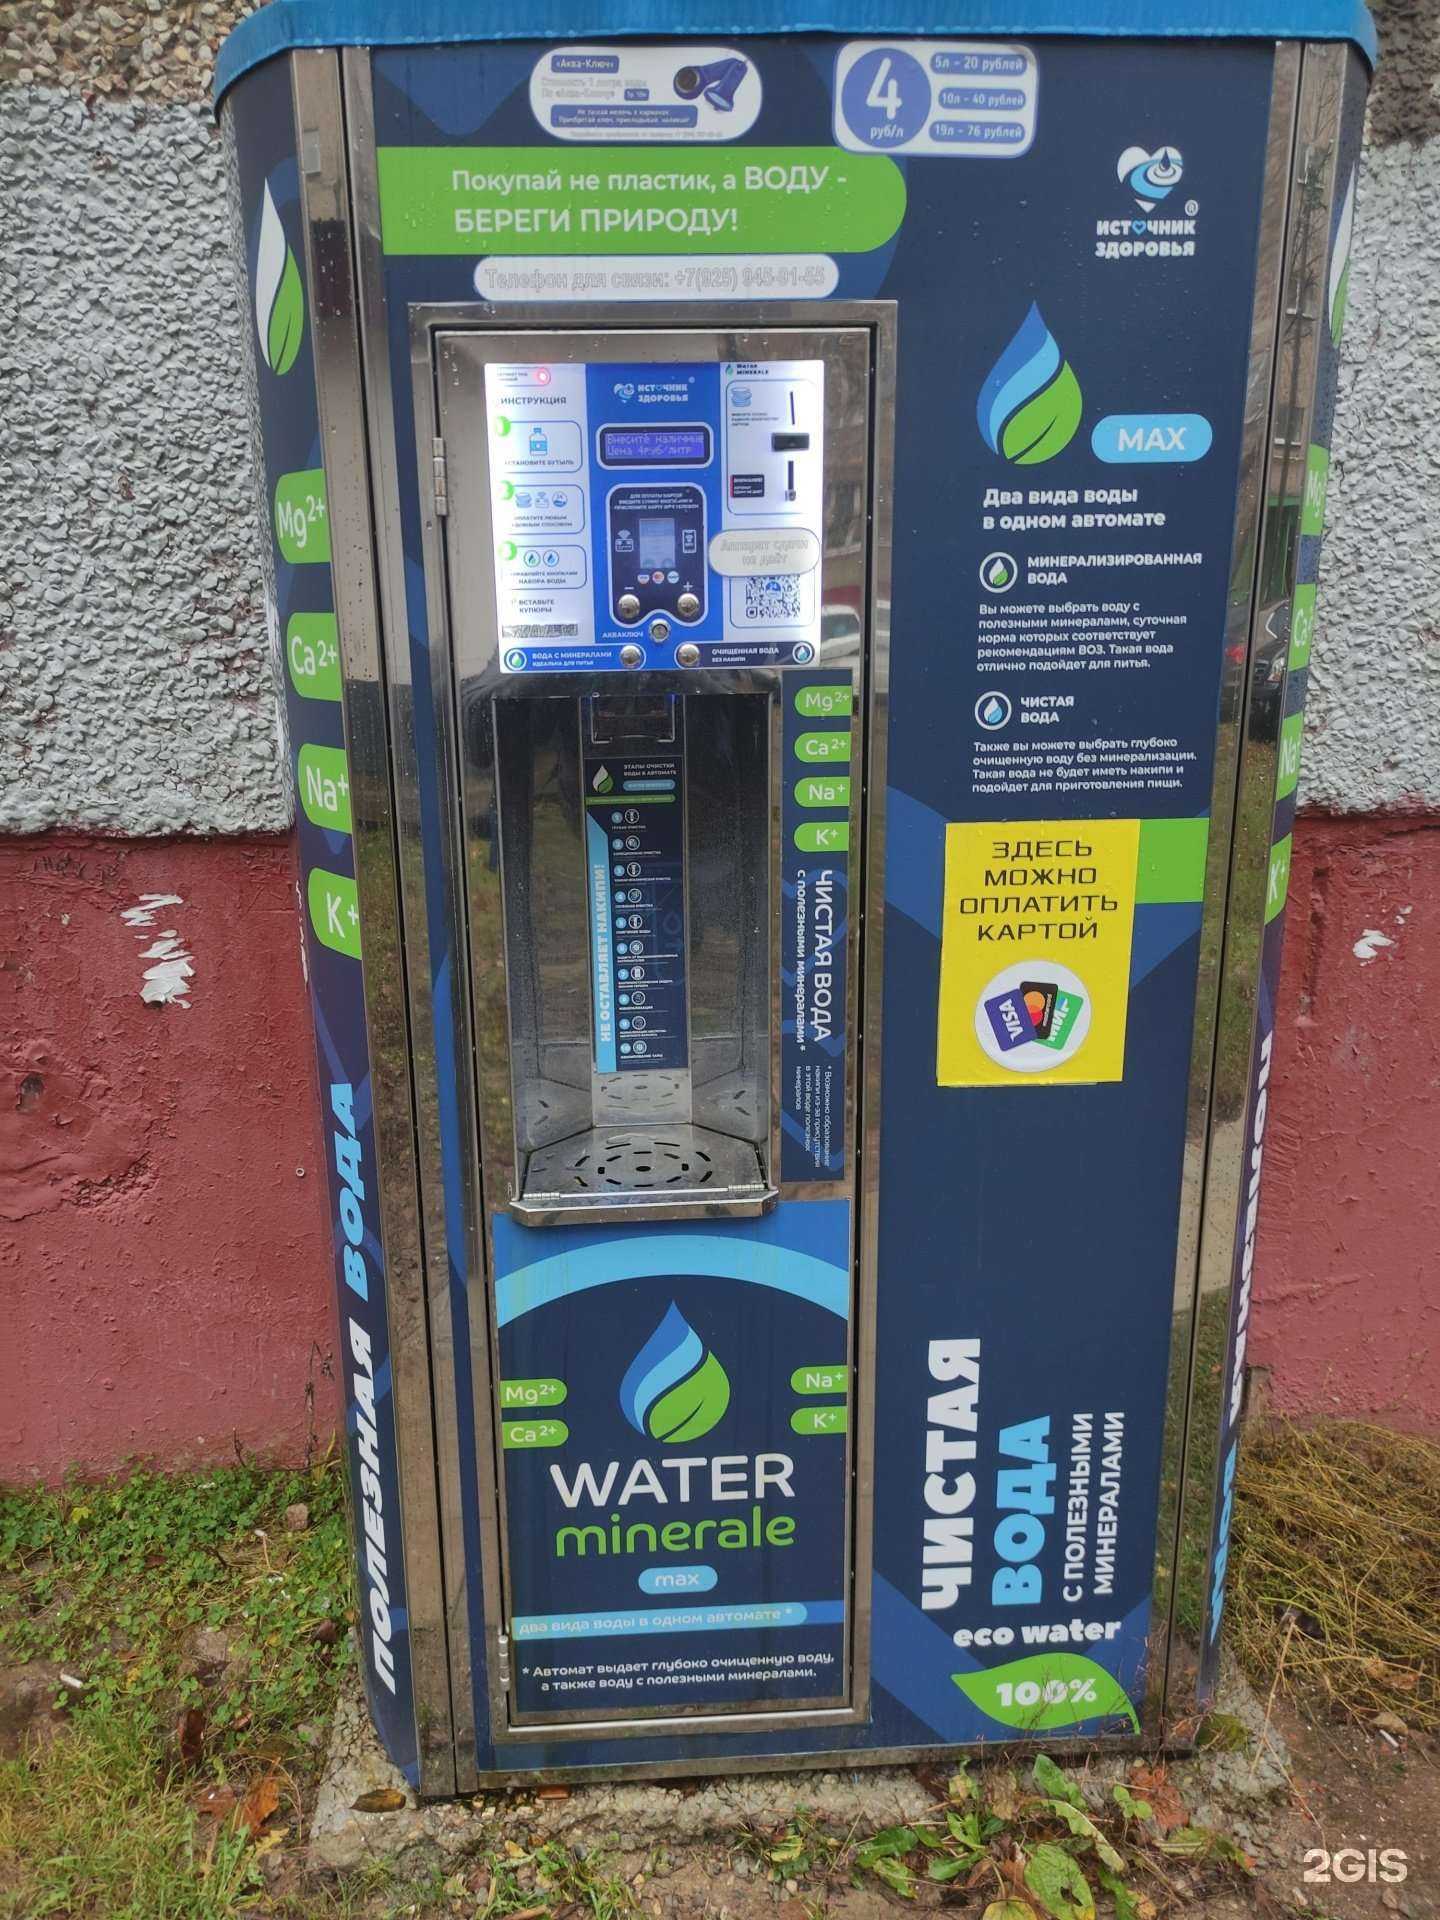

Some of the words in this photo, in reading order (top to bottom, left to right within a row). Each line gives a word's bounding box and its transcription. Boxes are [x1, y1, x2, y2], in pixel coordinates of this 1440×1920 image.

[935, 56, 950, 69] 5л
[964, 57, 978, 69] 20
[982, 58, 1024, 72] рублей
[866, 57, 903, 120] 4
[973, 93, 985, 104] 40
[988, 94, 1024, 108] рублей
[870, 124, 904, 140] руб/л
[967, 125, 981, 136] 76
[984, 126, 1022, 139] рублей
[452, 169, 563, 197] Покупай
[570, 173, 600, 191] не
[607, 173, 717, 195] пластик,
[722, 174, 738, 190] а
[744, 165, 830, 194] ВОДУ
[454, 207, 571, 233] БЕРЕГИ
[580, 207, 739, 235] ПРИРОДУ!
[1095, 240, 1196, 259] ЗДОРОВЬЯ
[485, 269, 568, 294] Телефон
[571, 272, 607, 291] для
[501, 396, 567, 406] ИНСТРУКЦИЯ
[638, 394, 689, 403] ЗДОРОВЬЯ
[607, 446, 632, 457] Цена
[983, 488, 1024, 508] Два
[1028, 488, 1079, 506] вида
[1084, 486, 1138, 505] воды
[983, 516, 994, 529] в
[999, 514, 1067, 532] одном
[1072, 512, 1167, 529] автомате
[1027, 553, 1203, 568] МИНЕРАЛИЗИРОВАННАЯ
[1027, 572, 1068, 586] ВОДА
[979, 604, 997, 614] Вы
[999, 603, 1046, 614] можете
[1048, 602, 1099, 614] выбрать
[1101, 602, 1131, 614] воду
[979, 619, 1048, 630] полезными
[1050, 617, 1130, 629] минералами,
[1133, 615, 1187, 628] суточная
[978, 632, 1017, 644] норма
[1019, 631, 1069, 643] которых
[1071, 629, 1157, 643] соответствует
[977, 645, 1076, 660] рекомендациям
[1078, 644, 1106, 655] ВОЗ.
[1108, 643, 1143, 655] Такая
[1145, 644, 1174, 655] вода
[977, 660, 1026, 672] отлично
[1028, 658, 1087, 672] подойдет
[1088, 658, 1111, 670] для
[1113, 658, 1151, 669] питья.
[1020, 695, 1075, 709] ЧИСТАЯ
[1020, 711, 1060, 725] ВОДА
[974, 742, 1010, 753] Также
[1012, 741, 1029, 751] вы
[1031, 740, 1076, 751] можете
[1078, 738, 1128, 750] выбрать
[1130, 737, 1178, 749] глубоко
[973, 755, 1044, 767] очищенную
[1046, 754, 1074, 766] воду
[1076, 752, 1097, 764] без
[1099, 751, 1197, 763] минерализации.
[973, 769, 1006, 780] Такая
[1008, 768, 1036, 779] вода
[1039, 769, 1054, 778] не
[1056, 766, 1090, 778] будет
[1091, 766, 1127, 778] иметь
[1130, 765, 1173, 776] накипи
[1176, 765, 1184, 775] и
[808, 783, 846, 801] Na+
[972, 782, 1029, 794] подойдет
[1030, 781, 1052, 794] для
[1055, 780, 1145, 793] приготовления
[1147, 778, 1183, 790] пищи.
[816, 828, 839, 846] K+
[992, 840, 1093, 863] ЗДЕСЬ
[984, 867, 1097, 887] МОЖНО
[594, 864, 608, 933] НАКИПИ!
[960, 895, 1119, 915] ОПЛАТИТЬ
[796, 879, 806, 957] полезными
[814, 869, 833, 967] ЧИСТАЯ
[977, 916, 1098, 941] КАРТОЙ
[597, 935, 611, 1021] ОСТАВЛЯЕТ
[811, 972, 833, 1042] ВОДА
[999, 998, 1024, 1042] VISA
[600, 1023, 612, 1042] НЕ
[330, 1082, 371, 1304] ВОДА
[805, 1370, 845, 1389] Na+
[505, 1384, 558, 1404] Mg2+
[813, 1411, 839, 1429] K+
[509, 1424, 558, 1444] Ca2+
[549, 1452, 796, 1509] WATER
[921, 1338, 982, 1611] ЧИСТАЯ
[992, 1415, 1058, 1606] ВОДА
[1062, 1411, 1094, 1579] ПОЛЕЗНЫМИ
[1093, 1411, 1125, 1597] МИНЕРАЛАМИ
[348, 1316, 397, 1696] ПОЛЕЗНАЯ
[555, 1504, 797, 1558] minerale
[655, 1571, 700, 1588] max
[1062, 1584, 1083, 1603] С
[518, 1621, 548, 1636] два
[551, 1619, 590, 1634] вида
[593, 1616, 636, 1632] воды
[639, 1616, 649, 1626] в
[652, 1612, 703, 1628] одном
[706, 1609, 781, 1625] автомате
[952, 1625, 1016, 1649] eco
[1021, 1617, 1123, 1644] water
[533, 1662, 594, 1678] Автомат
[597, 1660, 648, 1675] выдает
[651, 1657, 708, 1673] глубоко
[711, 1653, 795, 1670] очищенную
[797, 1651, 835, 1666] воду,
[541, 1681, 549, 1691] а
[552, 1679, 596, 1691] также
[599, 1676, 633, 1691] воду
[636, 1675, 644, 1684] с
[647, 1671, 725, 1685] полезными
[728, 1666, 818, 1682] минералами.
[996, 1677, 1098, 1708] 100%
